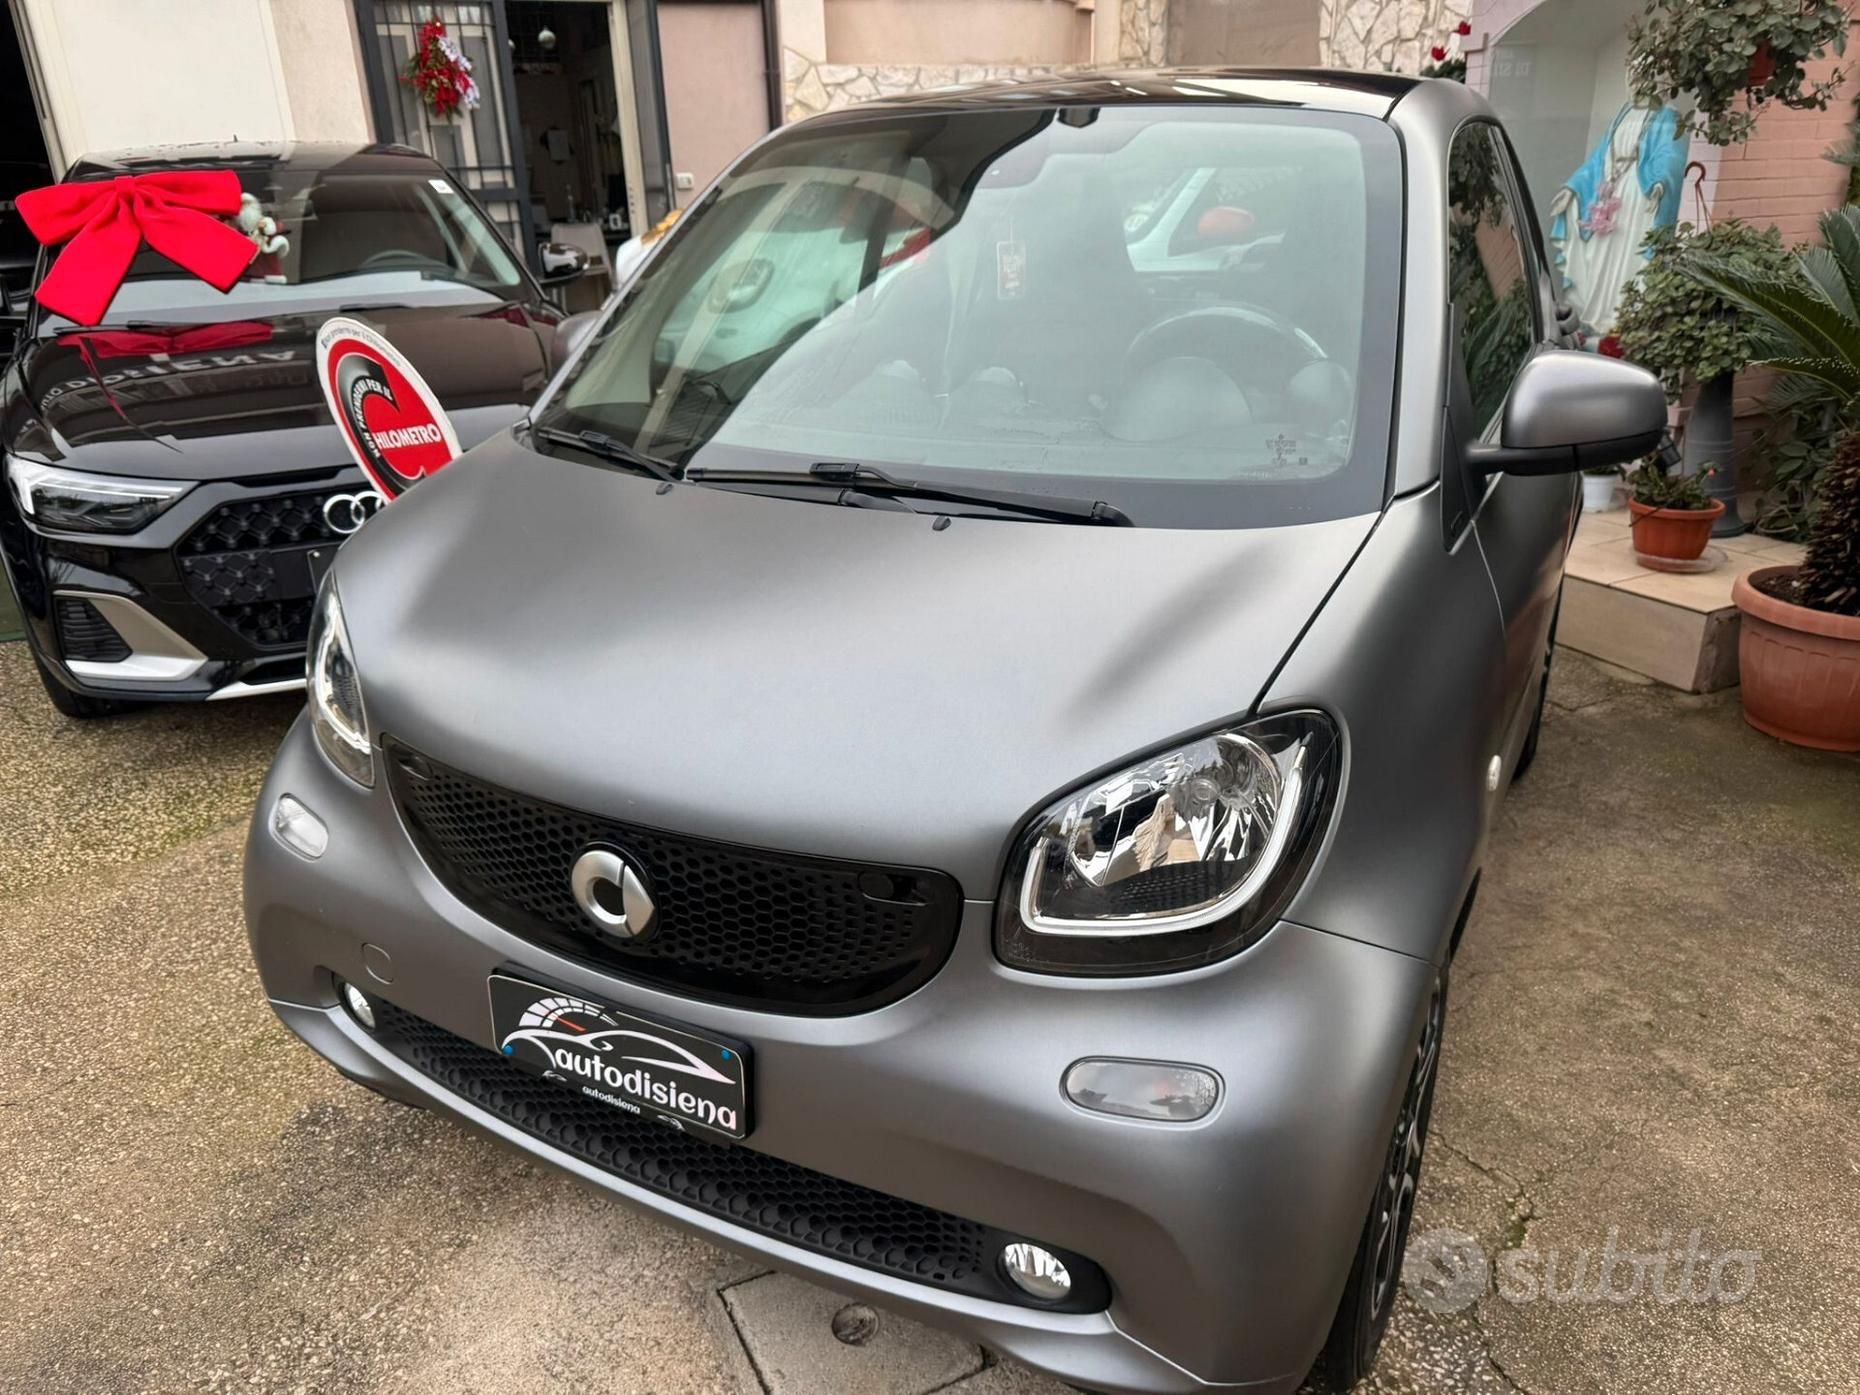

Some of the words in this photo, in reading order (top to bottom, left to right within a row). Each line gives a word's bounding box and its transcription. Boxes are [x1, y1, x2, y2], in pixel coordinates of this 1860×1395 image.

[365, 378, 383, 394] PER
[363, 432, 380, 458] NON
[554, 1048, 737, 1131] autodisiena
[582, 1084, 641, 1115] autodisiena
